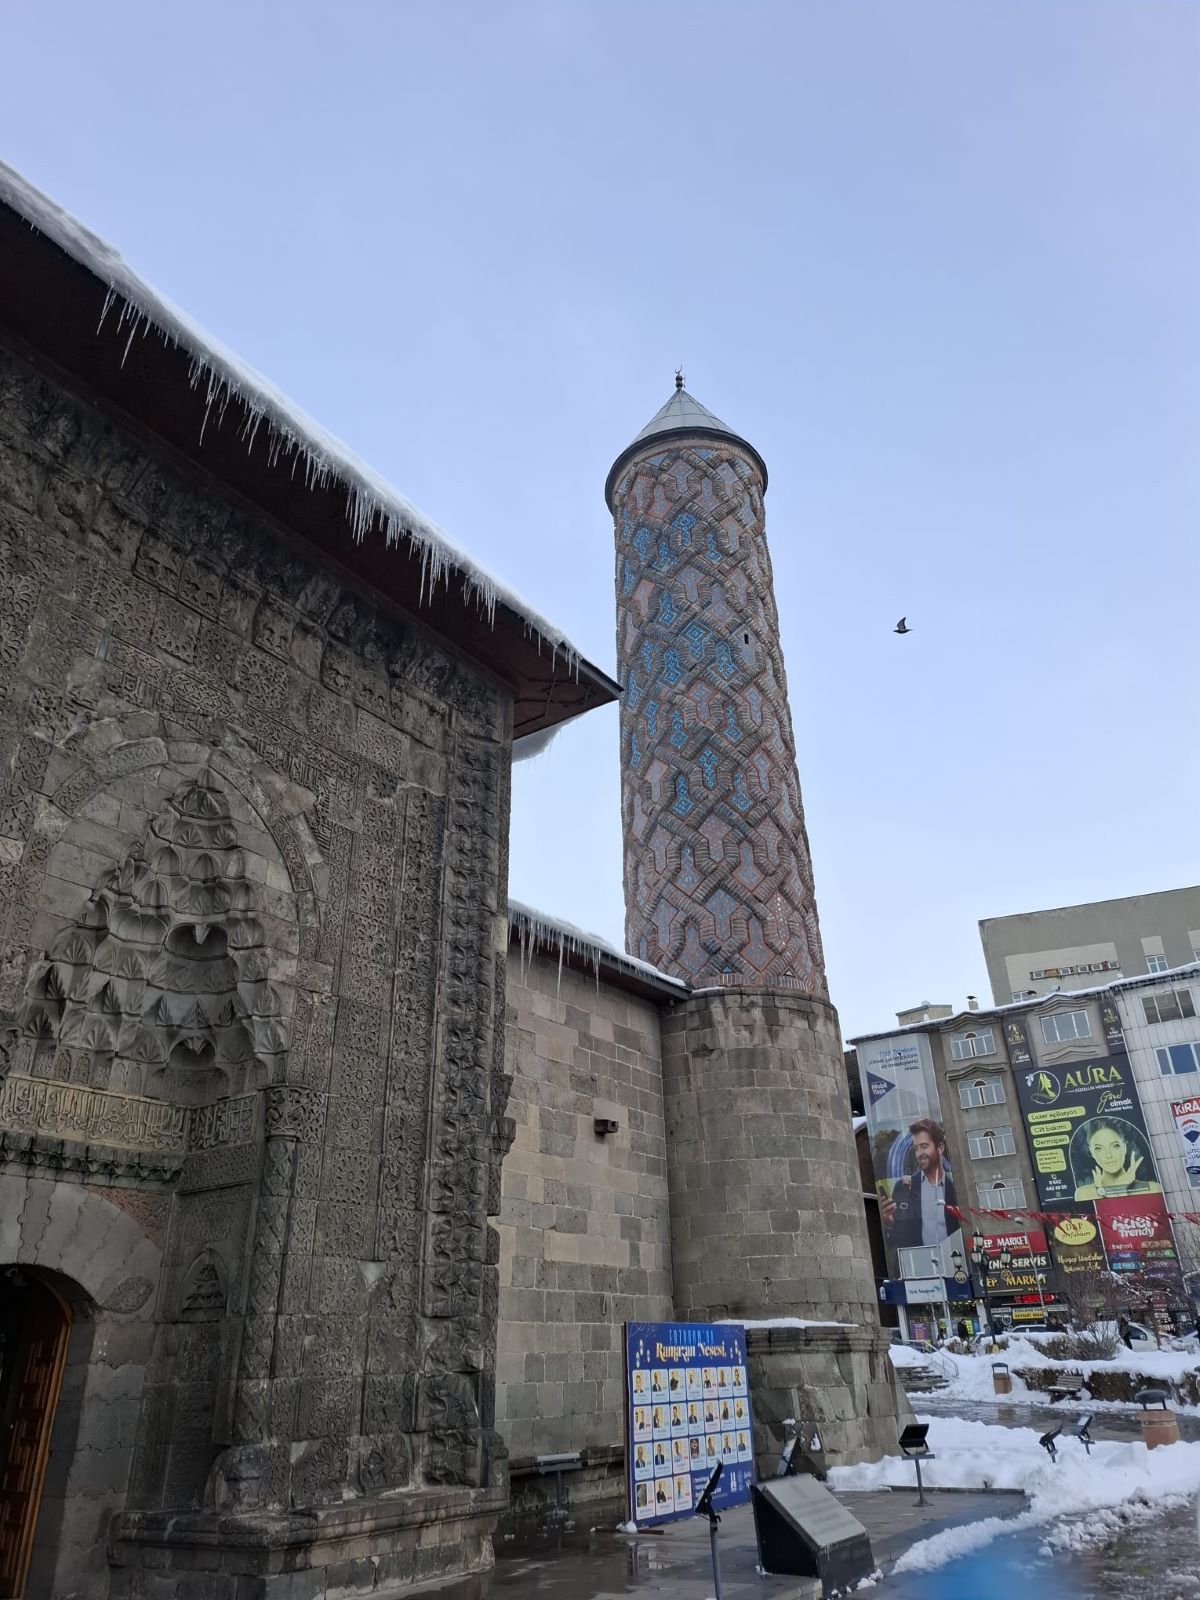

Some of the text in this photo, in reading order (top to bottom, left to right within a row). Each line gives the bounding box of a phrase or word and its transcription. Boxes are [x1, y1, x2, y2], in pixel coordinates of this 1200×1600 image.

[1064, 1065, 1123, 1088] AURA
[1110, 1098, 1132, 1108] olmak
[1032, 1109, 1077, 1121] Lazer epilasyon
[1035, 1136, 1067, 1146] Dermapen
[1120, 1226, 1154, 1238] Trendy
[982, 1236, 1028, 1249] EP MARKET
[1012, 1255, 1047, 1268] SERVİS
[1006, 1274, 1047, 1286] MARKT
[656, 1342, 696, 1362] Ramazan
